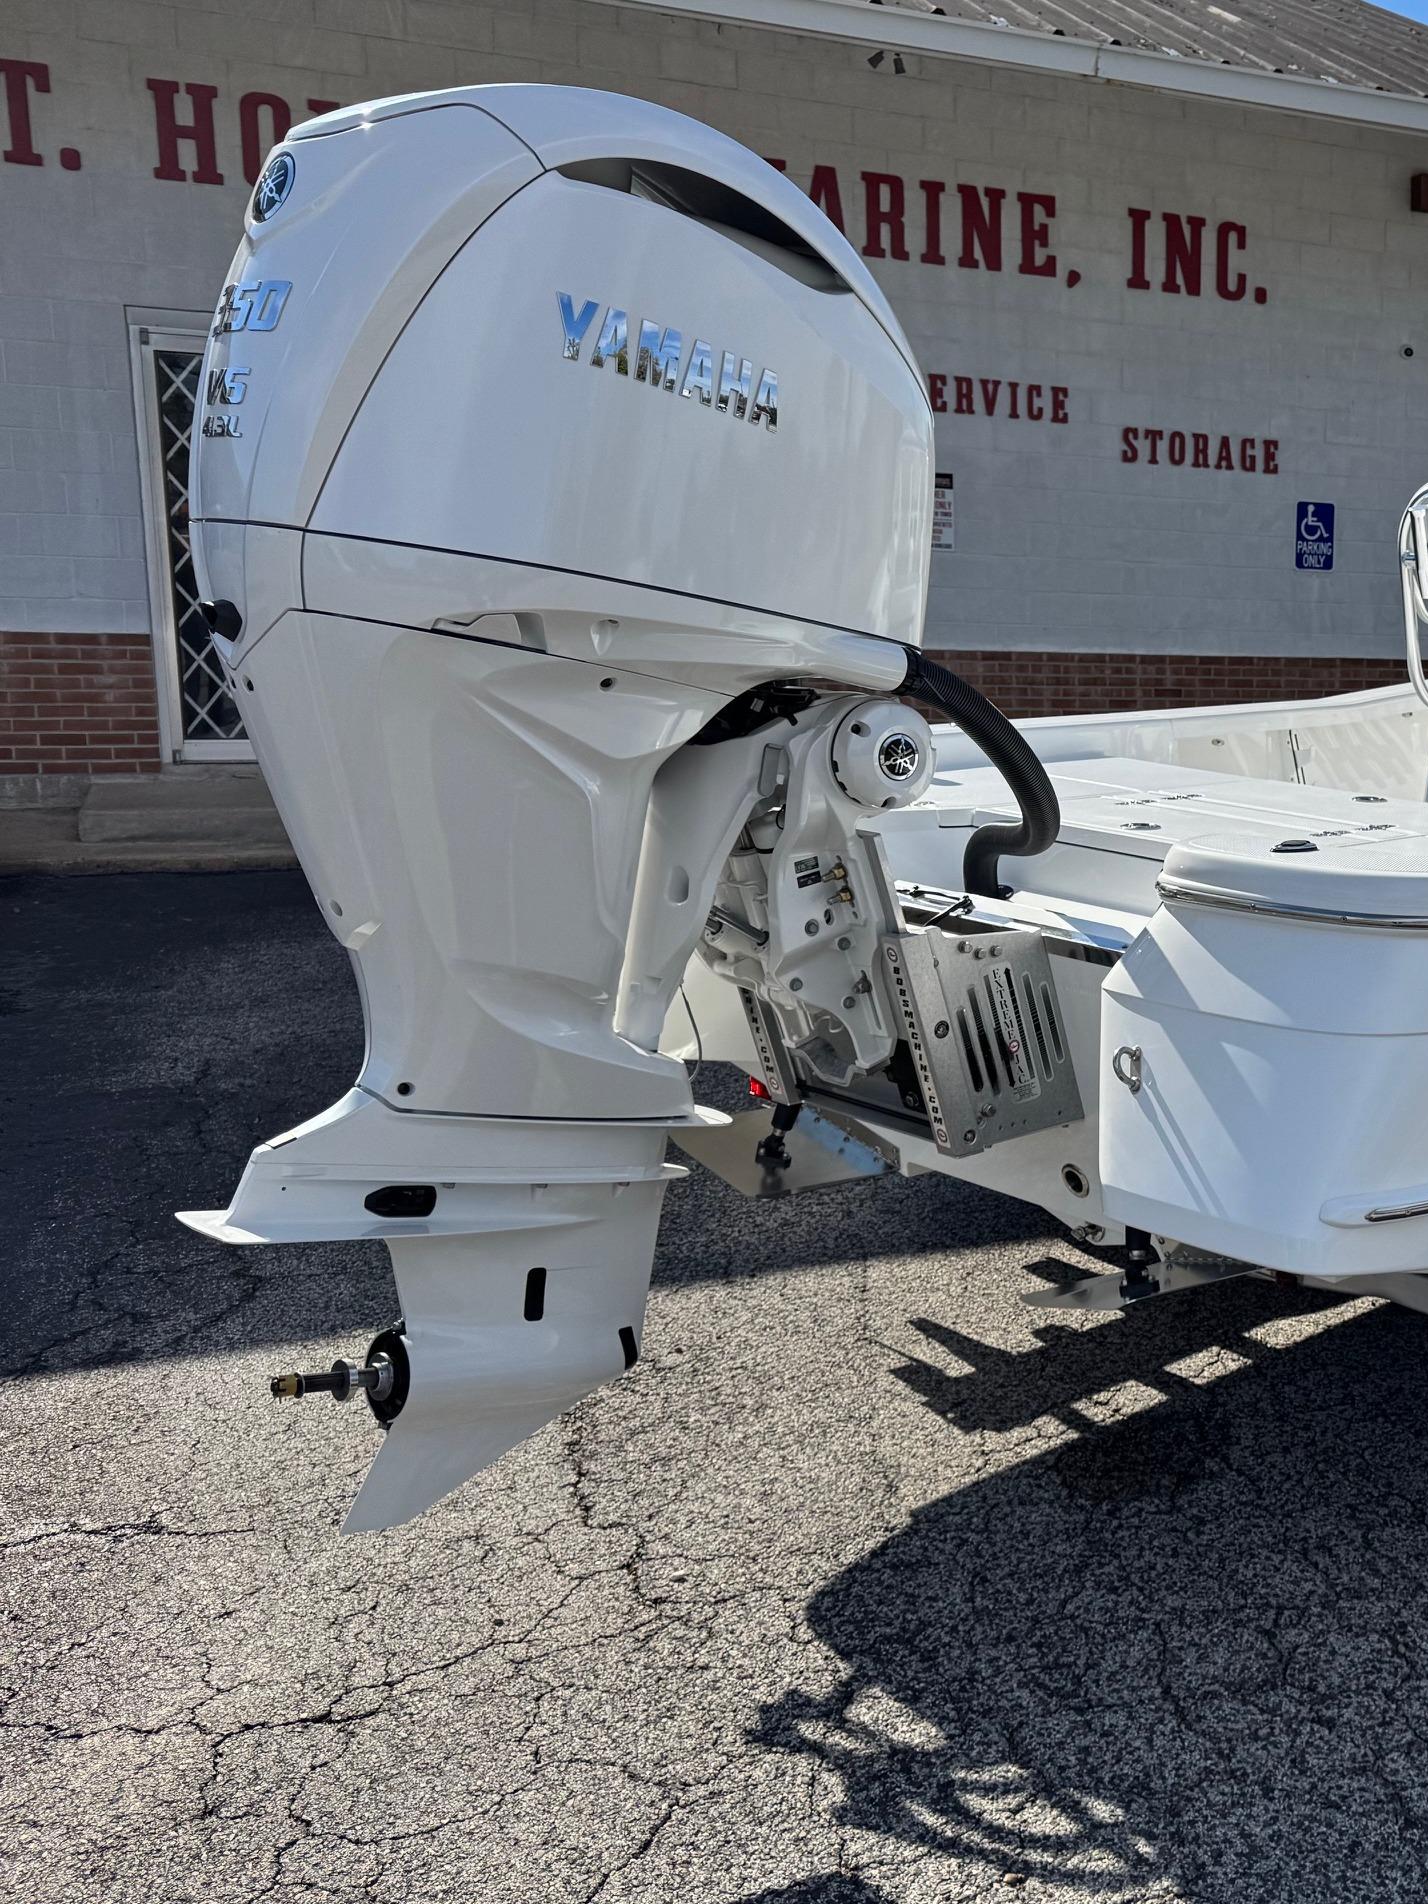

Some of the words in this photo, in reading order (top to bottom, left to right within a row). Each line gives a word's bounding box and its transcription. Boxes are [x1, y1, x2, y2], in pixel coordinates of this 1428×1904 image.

[763, 157, 1082, 289] ARINE,
[1126, 207, 1268, 305] INC.
[556, 291, 779, 434] YAMAHA
[928, 373, 1069, 424] ERVICE
[1121, 426, 1280, 475] STORAGE
[1297, 541, 1332, 555] PARKING
[1303, 554, 1326, 568] ONLY
[992, 968, 1017, 1039] EXTREME
